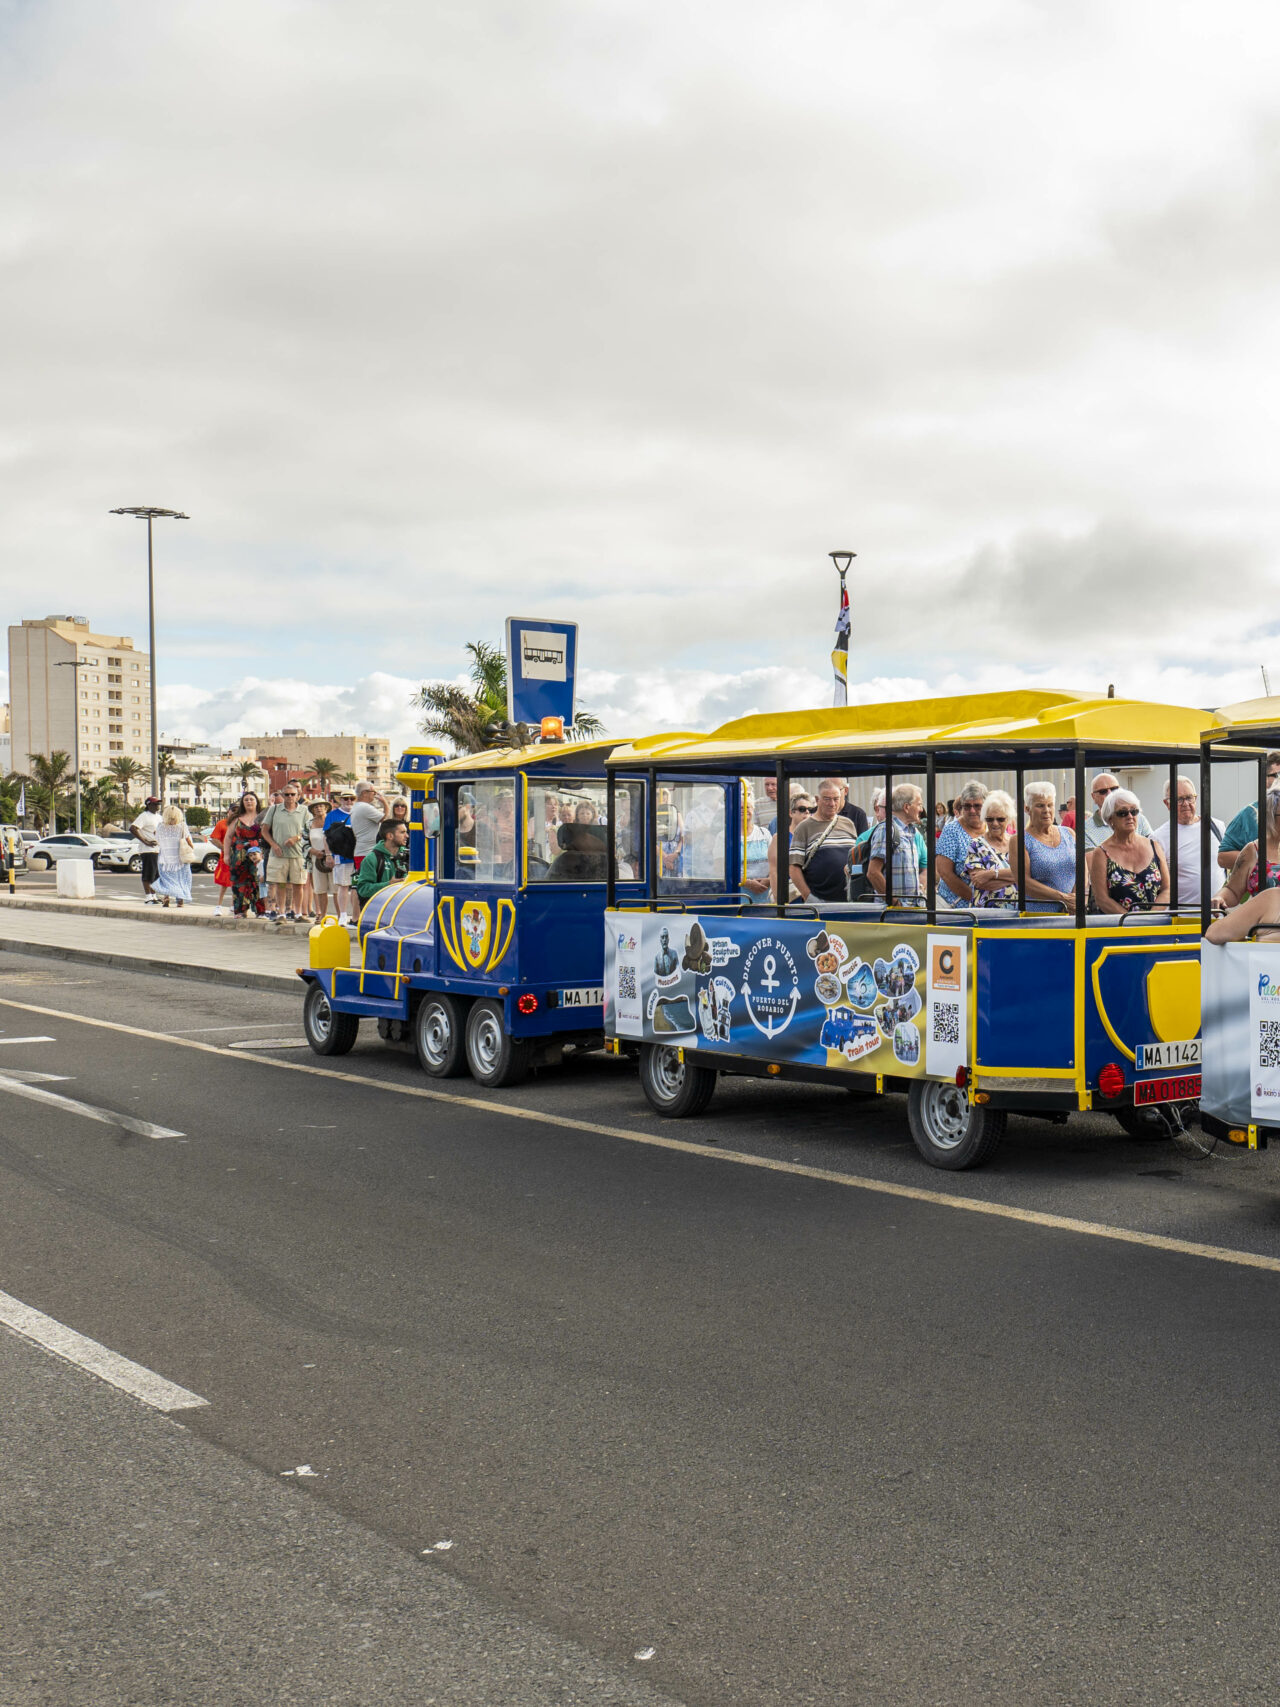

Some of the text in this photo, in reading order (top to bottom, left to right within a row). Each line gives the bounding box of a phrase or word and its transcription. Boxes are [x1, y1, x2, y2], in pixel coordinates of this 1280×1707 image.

[742, 937, 799, 985] DISCOVER PUERTO
[842, 960, 859, 978] music
[564, 990, 582, 1006] MA
[752, 996, 790, 1006] PUERTO DEL
[757, 1004, 784, 1014] ROSARIO
[847, 1035, 881, 1058] Train tour
[1144, 1043, 1198, 1067] MA 1142
[1139, 1083, 1156, 1103] MA
